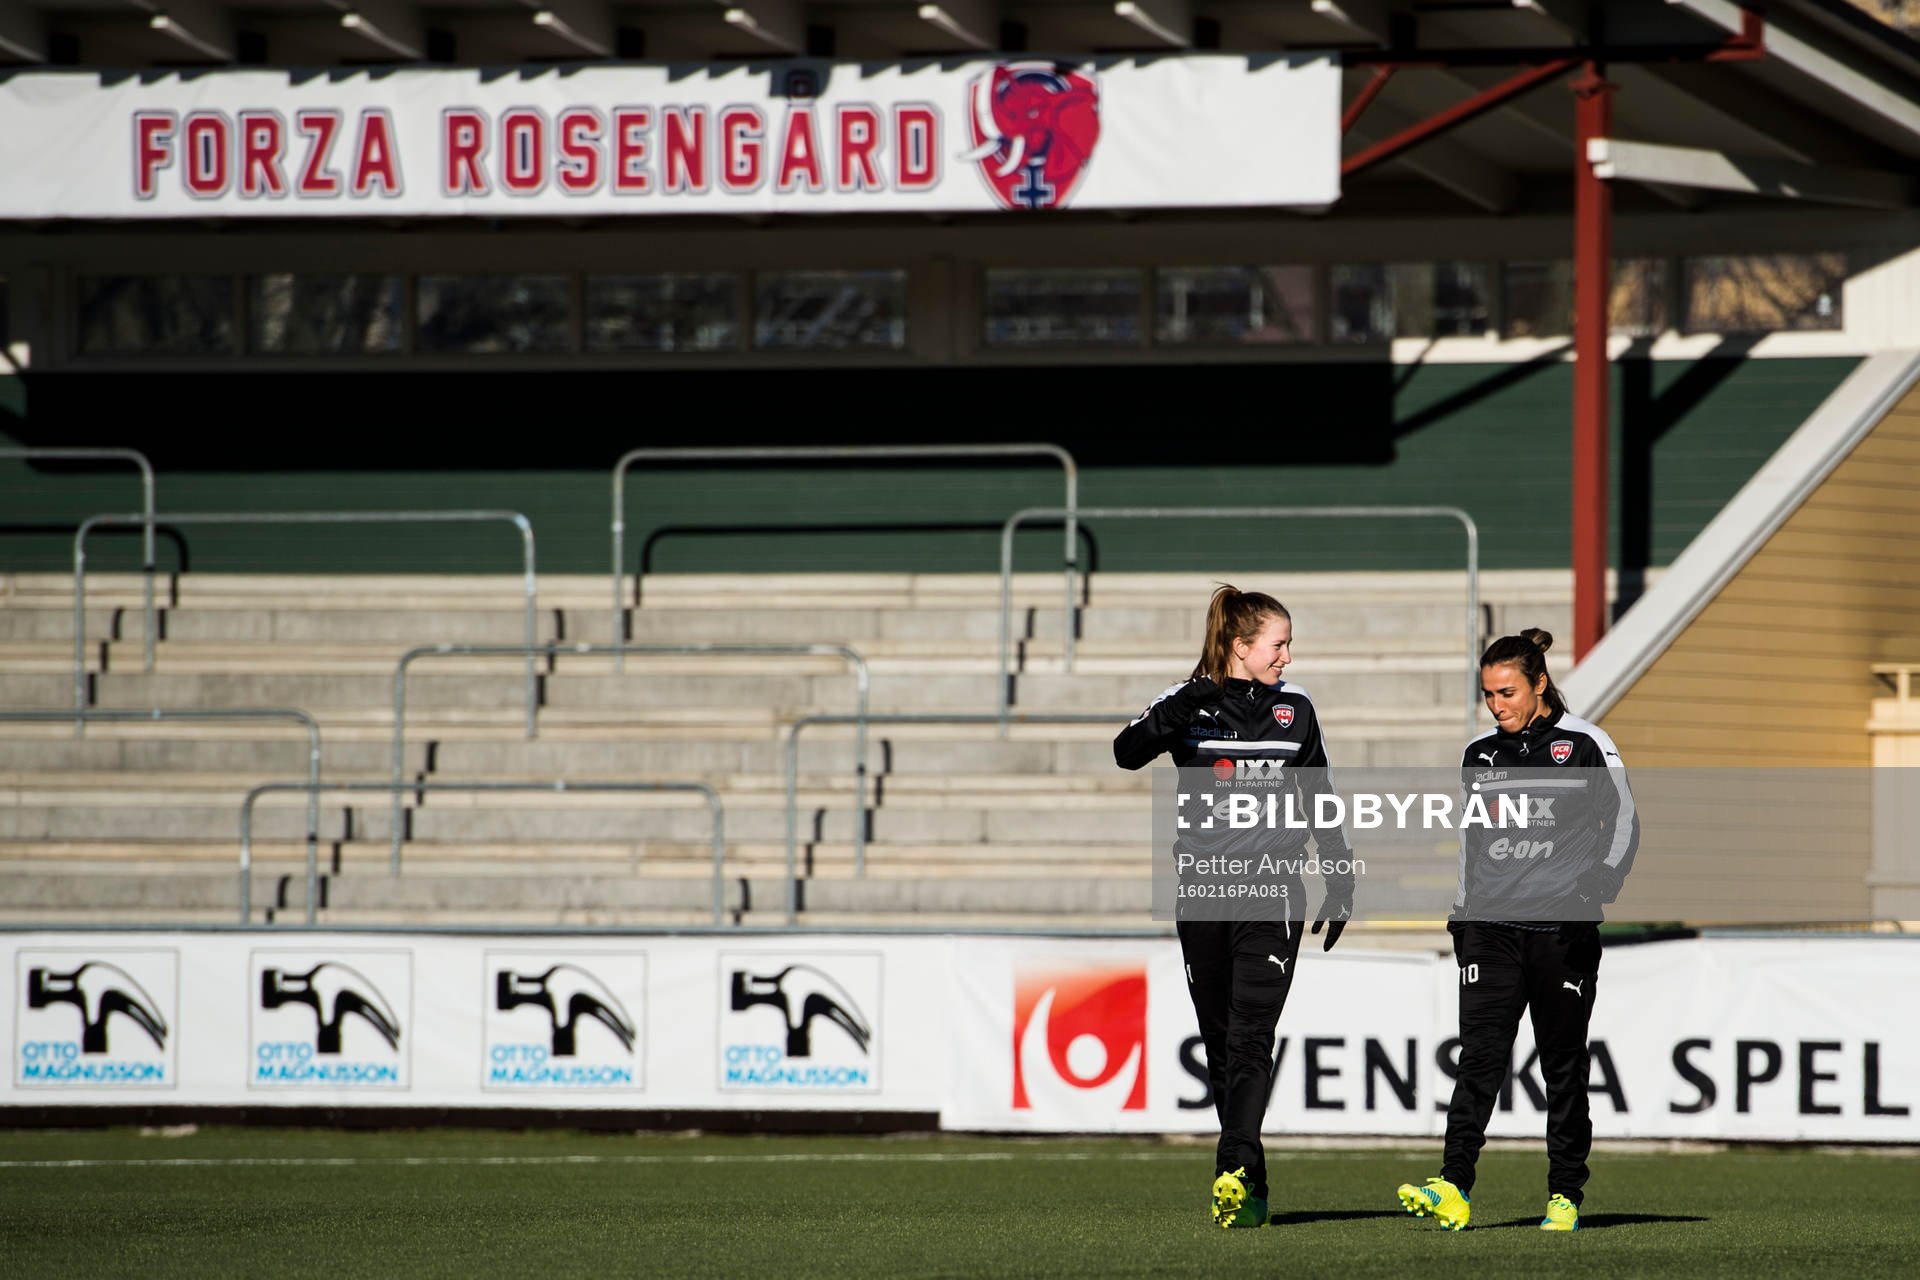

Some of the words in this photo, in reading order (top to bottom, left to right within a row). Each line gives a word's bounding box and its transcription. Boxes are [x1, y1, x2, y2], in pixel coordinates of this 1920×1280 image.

[133, 107, 404, 200] FORZA
[441, 70, 943, 196] ROSENGÅRD
[1276, 709, 1292, 717] FCR
[1236, 759, 1286, 780] IXX
[1235, 780, 1284, 788] IT-PARTNE
[1462, 964, 1479, 985] 10
[22, 1041, 79, 1061] OTTO
[257, 1042, 314, 1062] OTTO
[490, 1045, 549, 1065] OTTO
[725, 1046, 782, 1063] OTTO
[23, 1062, 165, 1081] MAGNUSSON
[257, 1063, 398, 1082] MAGNUSSON
[491, 1065, 633, 1085] MAGNUSSON
[726, 1066, 868, 1085] MAGNUSSON
[1669, 1038, 1910, 1116] SPEL
